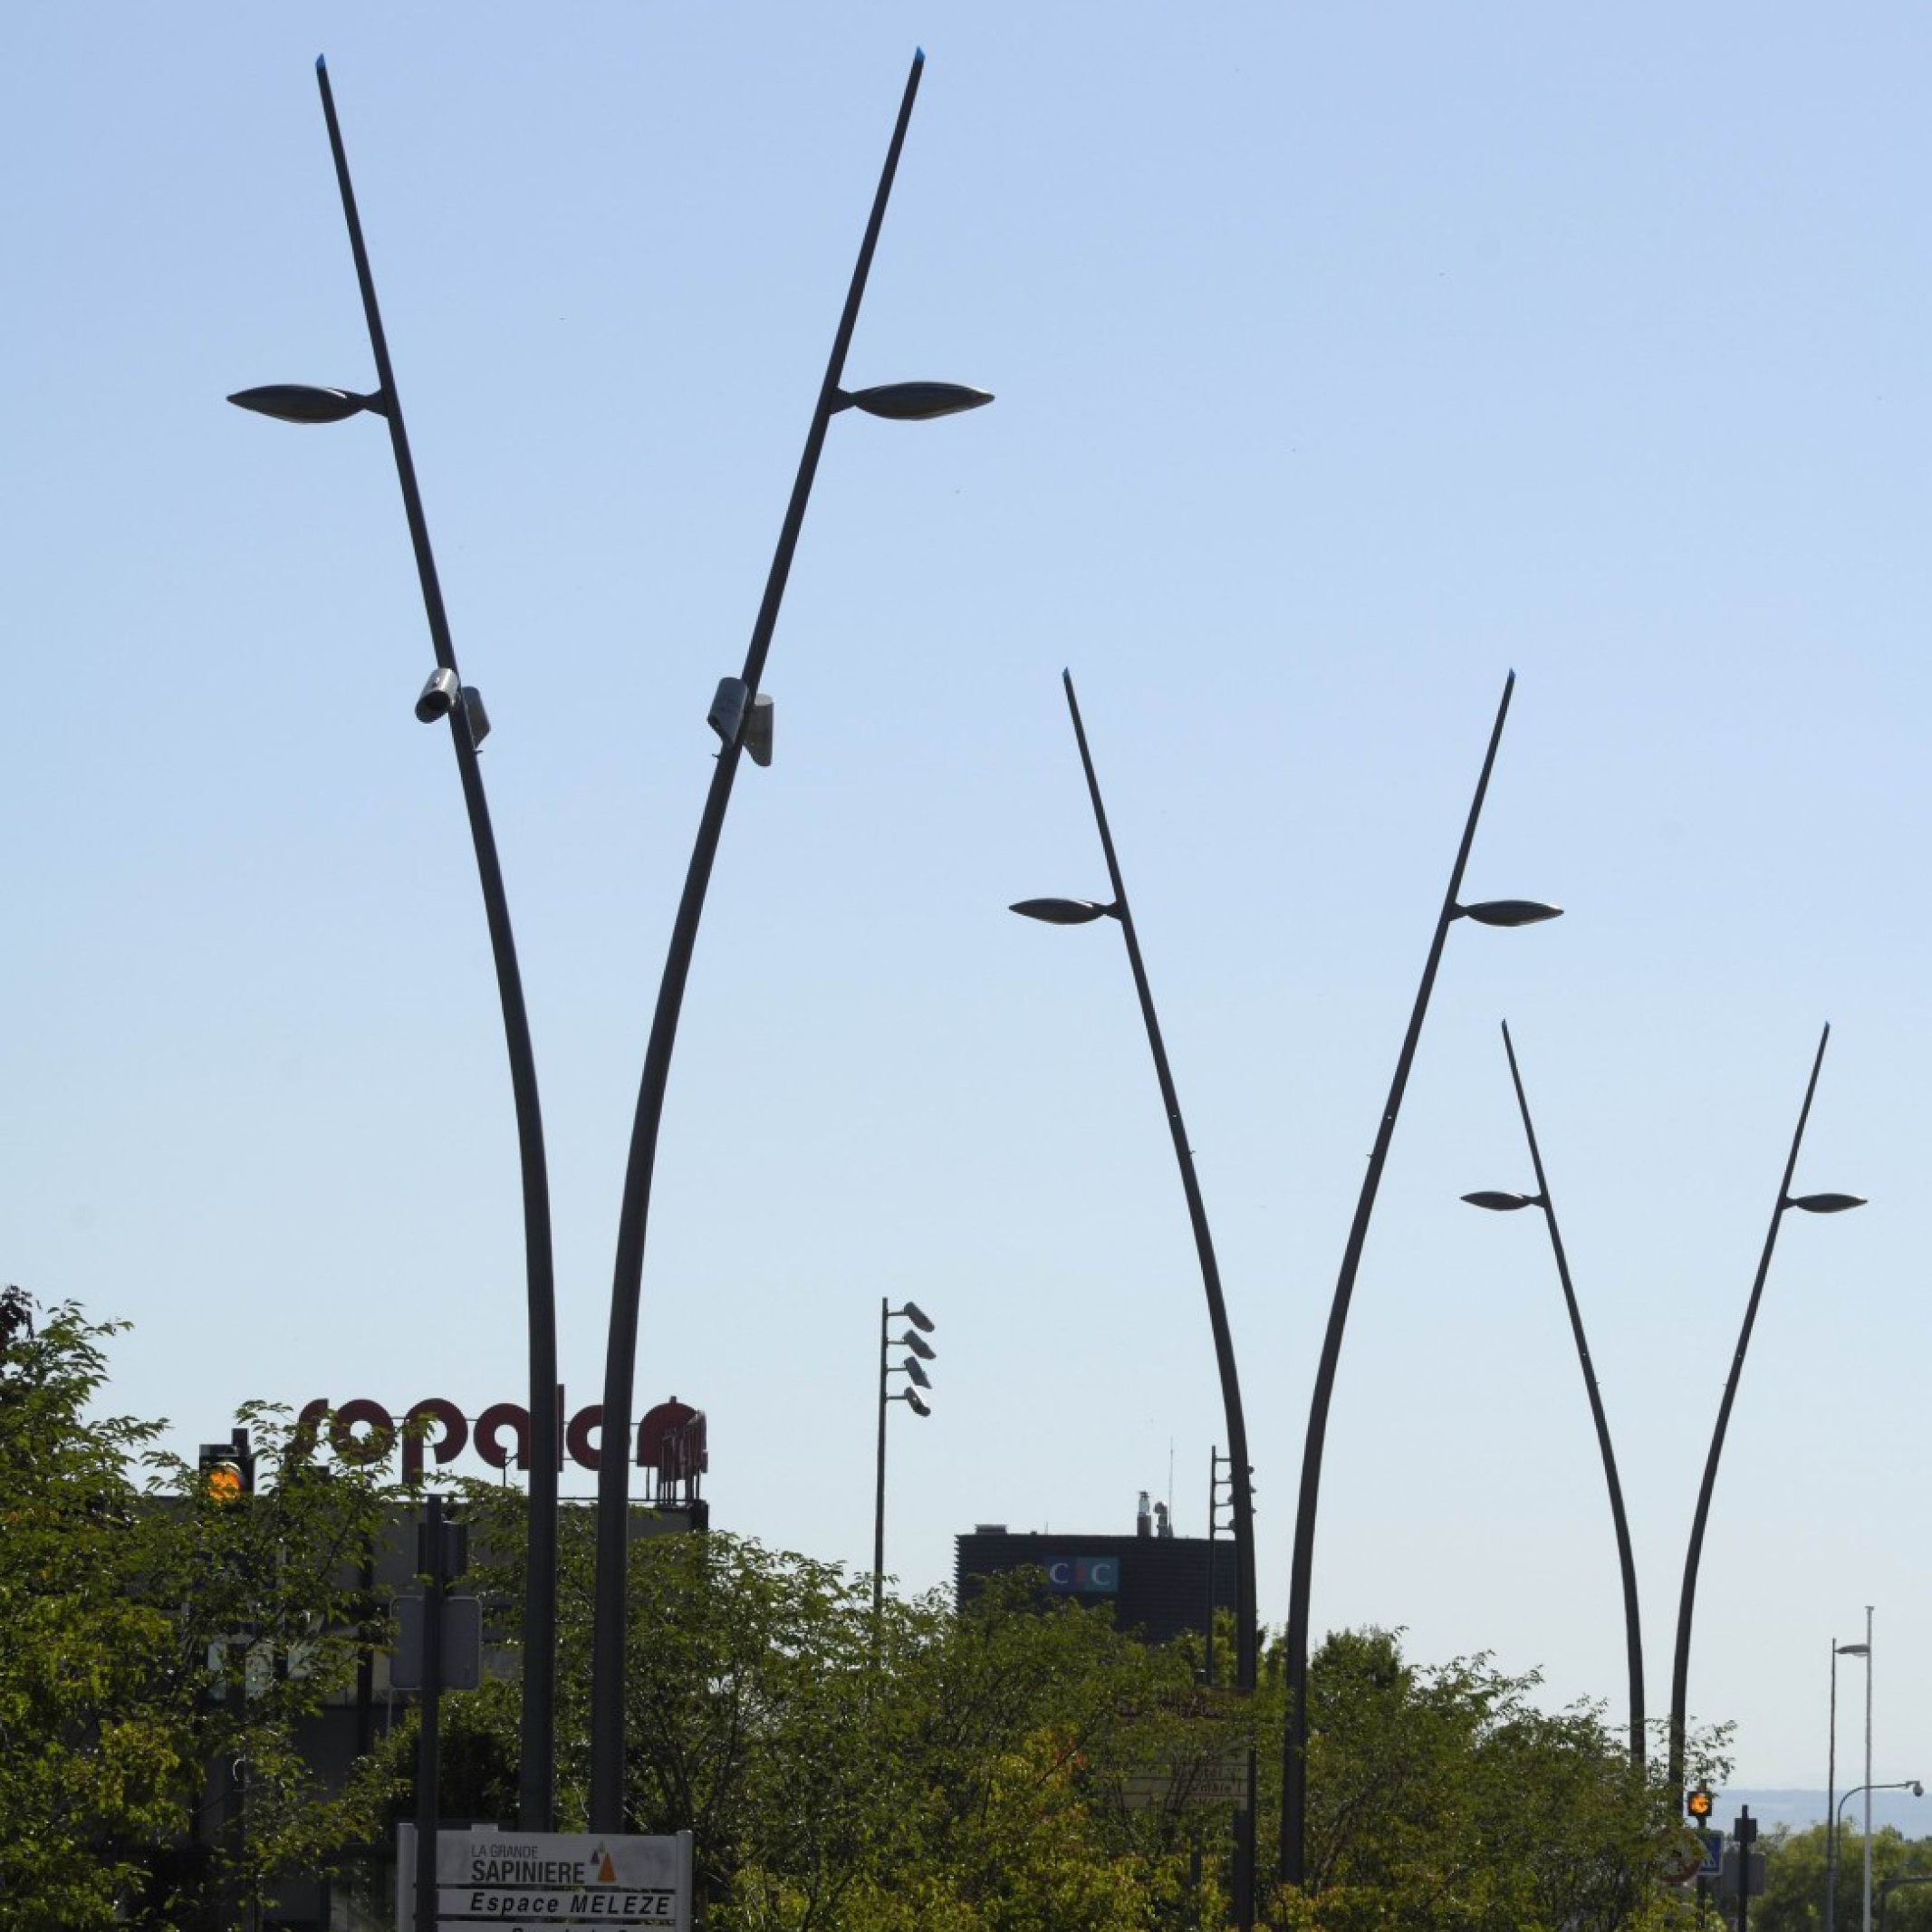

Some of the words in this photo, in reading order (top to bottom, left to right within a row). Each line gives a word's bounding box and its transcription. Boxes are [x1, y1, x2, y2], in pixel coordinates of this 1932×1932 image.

[1050, 1563, 1110, 1585] CIC
[471, 1844, 486, 1858] LA
[489, 1844, 538, 1859] GRANDE
[471, 1860, 586, 1884] SAPINIERE
[470, 1892, 559, 1916] Espace
[570, 1894, 670, 1915] MELEZE
